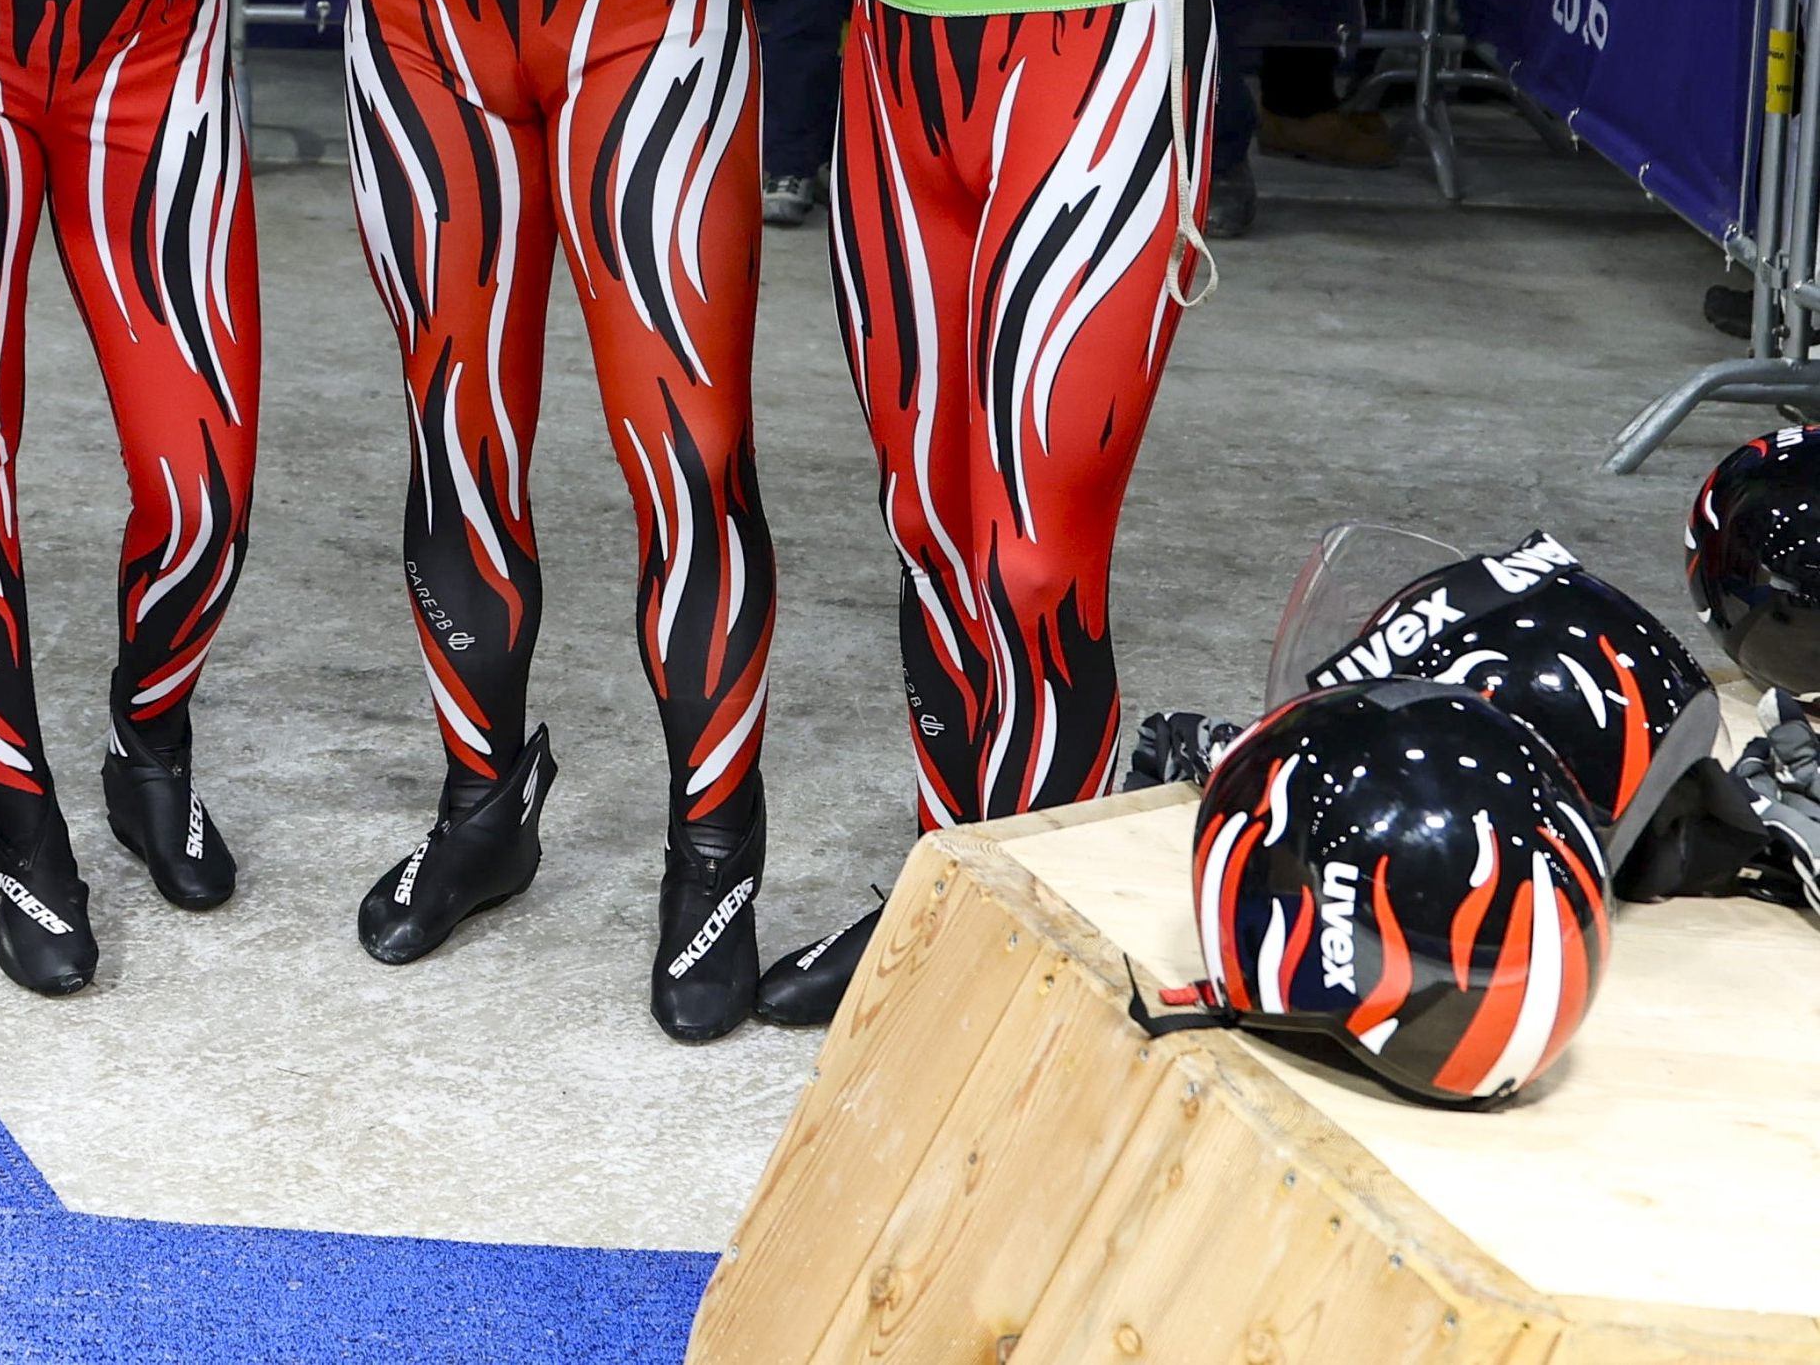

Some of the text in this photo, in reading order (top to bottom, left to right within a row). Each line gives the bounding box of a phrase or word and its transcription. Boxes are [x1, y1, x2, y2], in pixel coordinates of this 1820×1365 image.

[404, 560, 453, 632] DARE2B
[667, 876, 755, 980] SKECHERS
[1322, 860, 1359, 994] uvex
